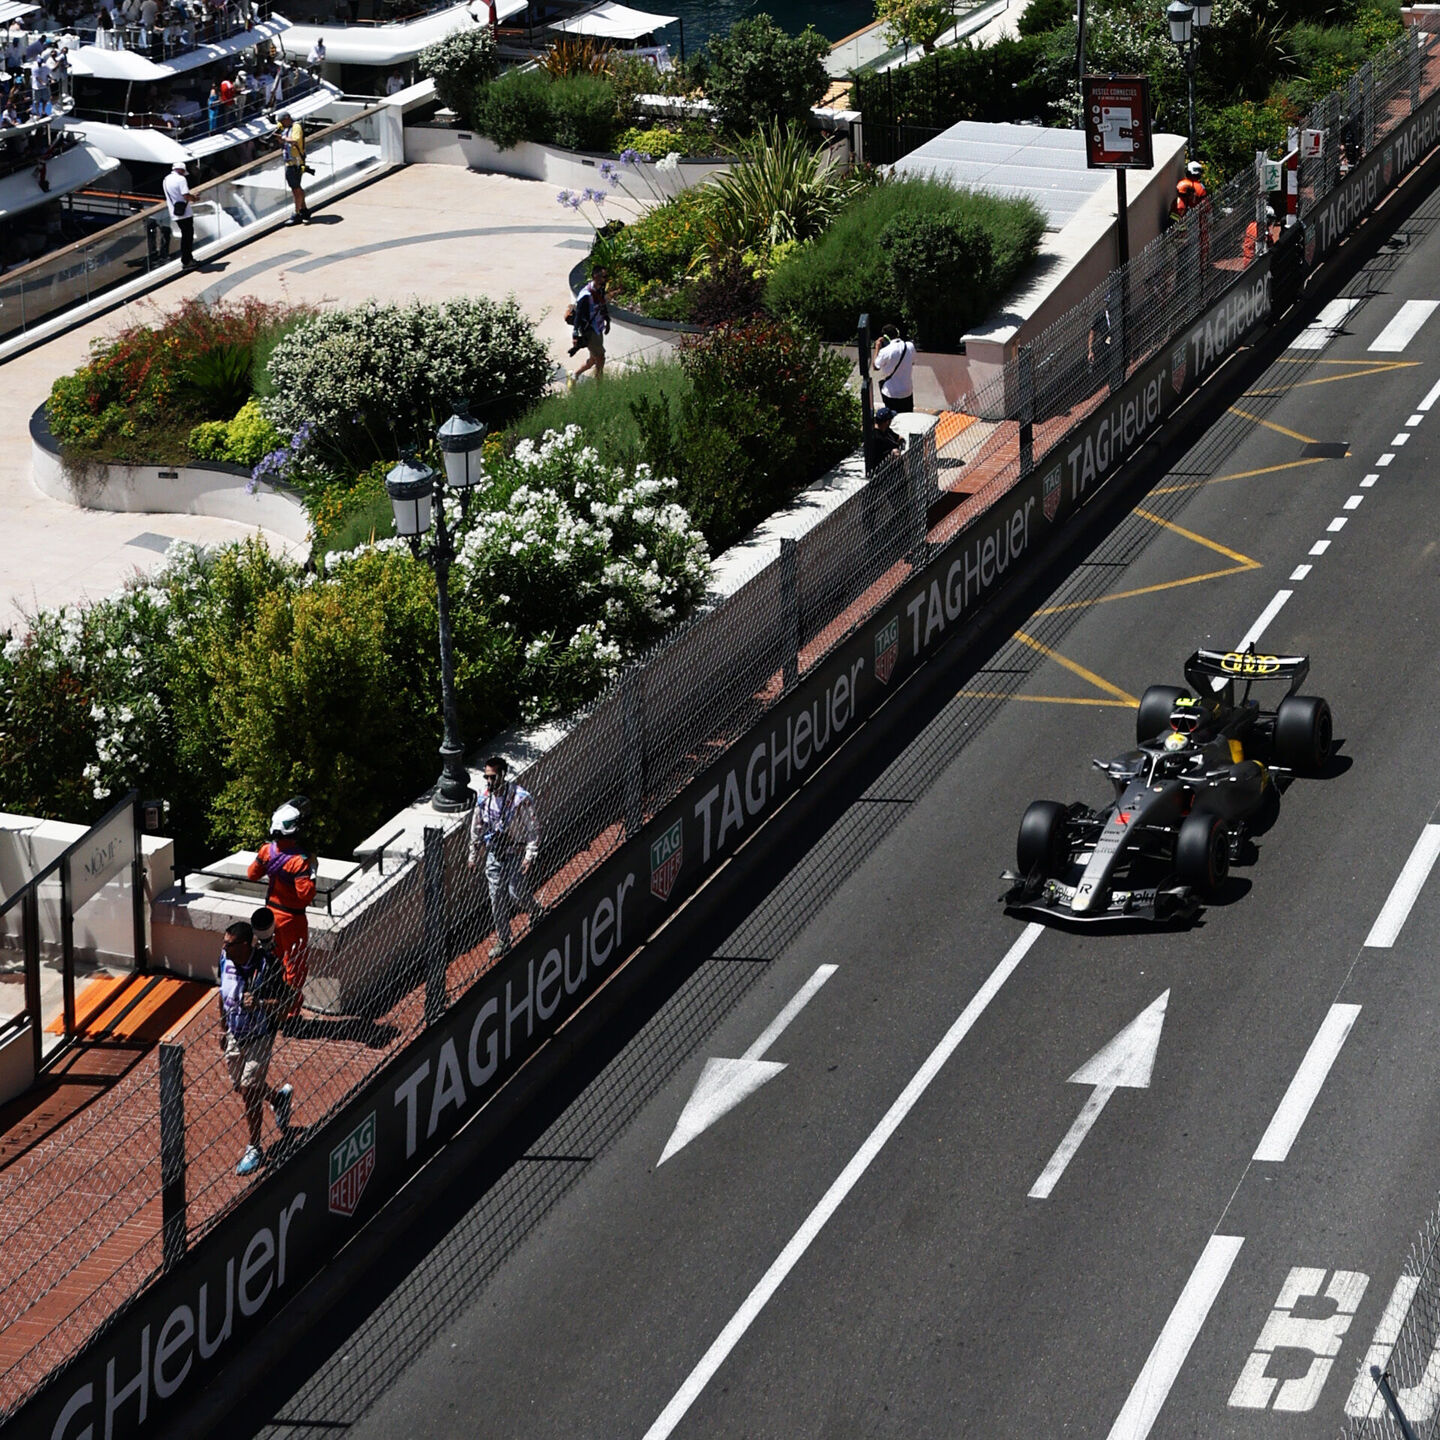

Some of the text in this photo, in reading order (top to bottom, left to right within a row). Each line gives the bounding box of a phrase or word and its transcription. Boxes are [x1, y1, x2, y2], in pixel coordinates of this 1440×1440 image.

[653, 830, 681, 865] TAG
[333, 1122, 374, 1174] TAG
[330, 1154, 375, 1216] HEUER
